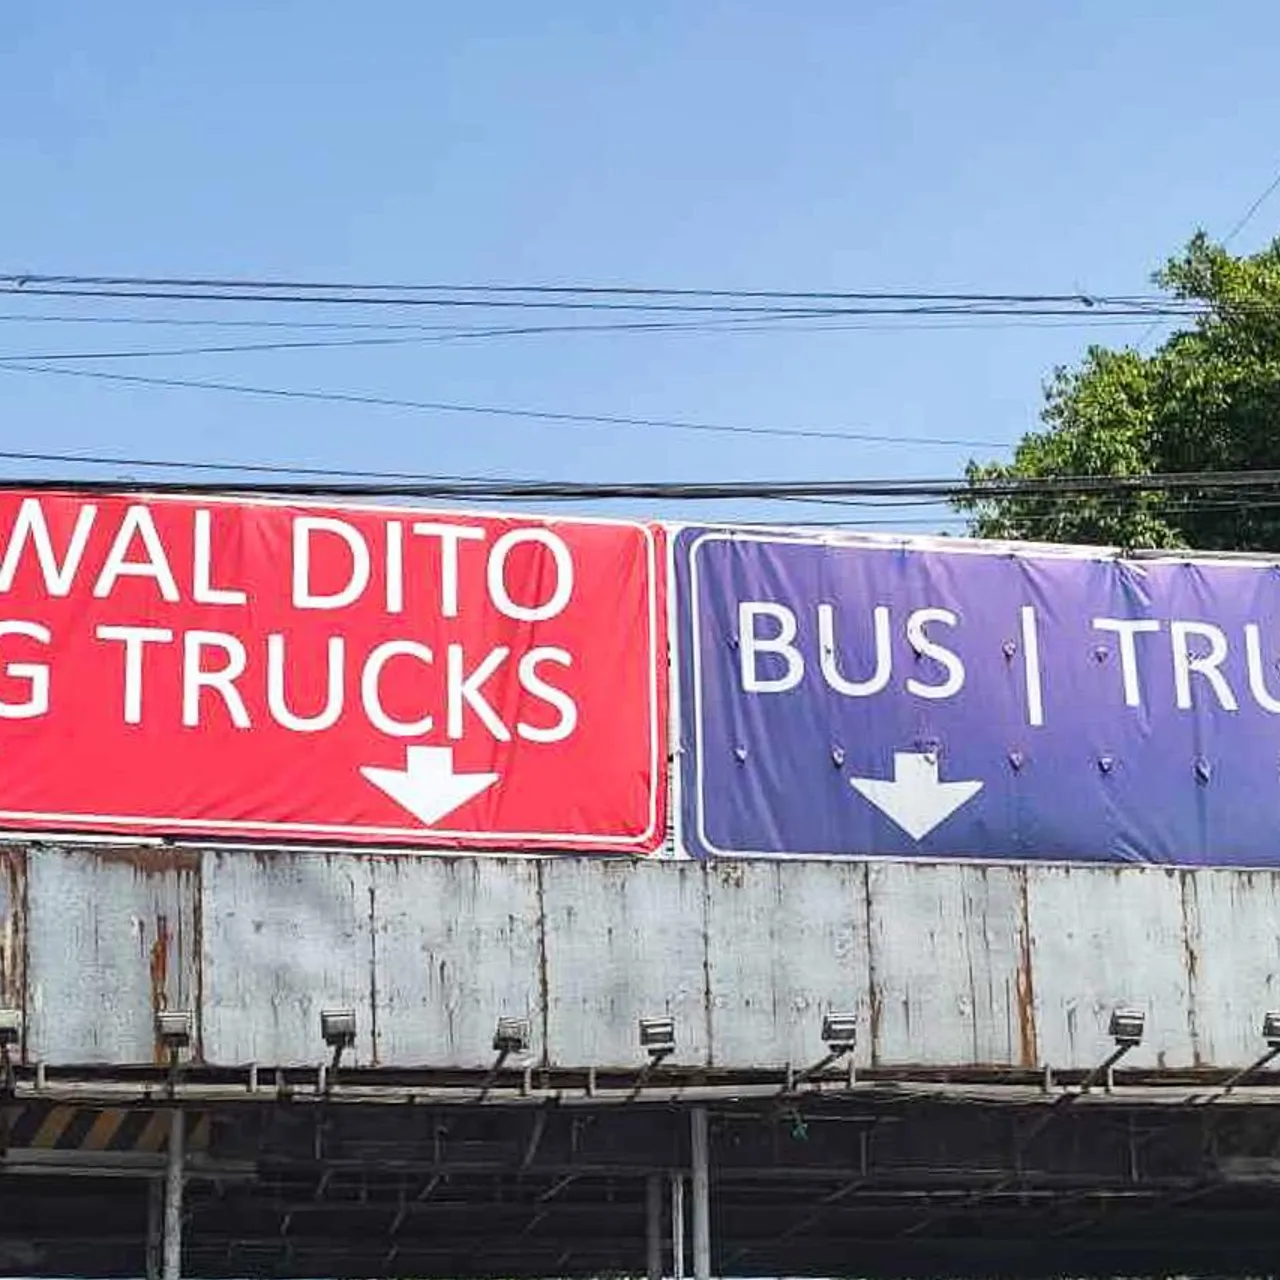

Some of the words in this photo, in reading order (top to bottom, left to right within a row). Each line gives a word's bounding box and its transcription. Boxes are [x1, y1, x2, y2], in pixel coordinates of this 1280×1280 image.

[292, 516, 575, 621] DITO
[98, 625, 579, 746] TRUCKS
[738, 603, 966, 699] BUS
